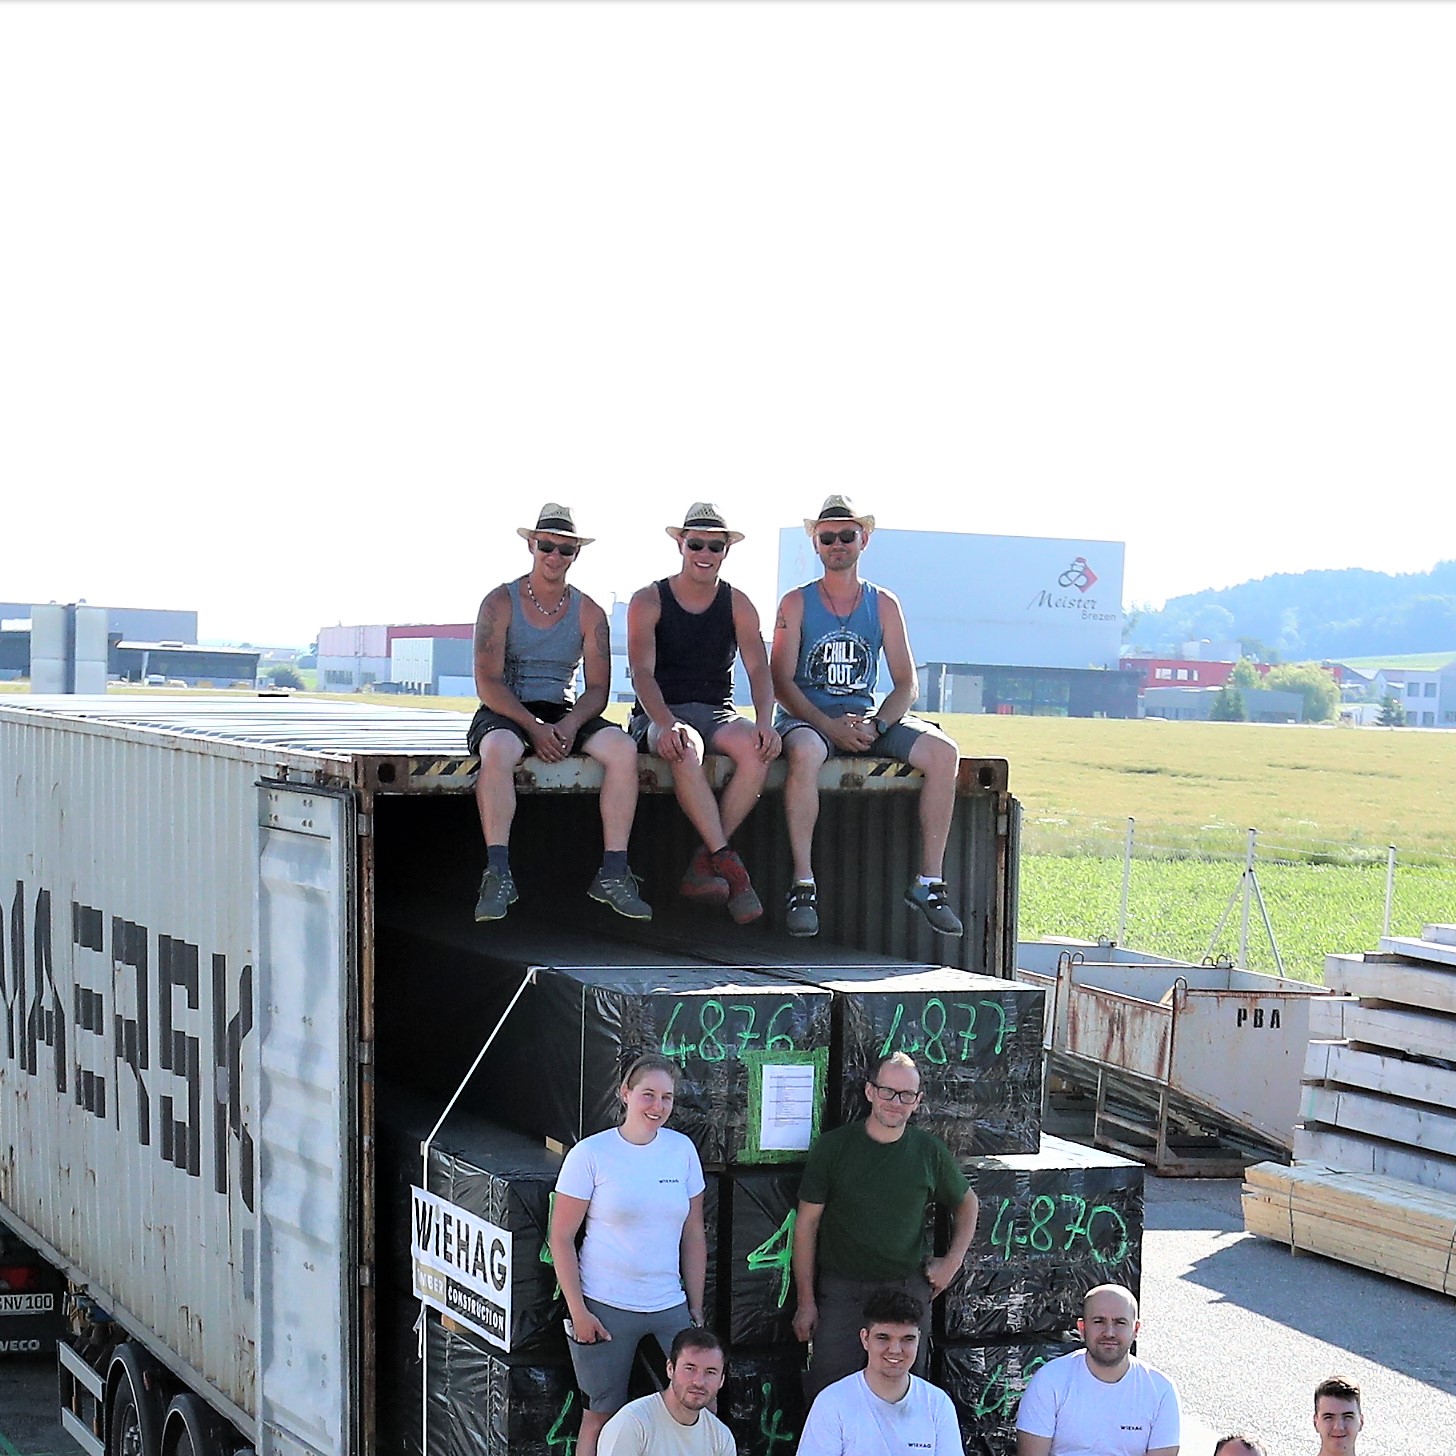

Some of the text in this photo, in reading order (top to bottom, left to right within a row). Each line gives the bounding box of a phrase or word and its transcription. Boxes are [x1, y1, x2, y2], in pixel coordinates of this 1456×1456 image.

[1027, 590, 1097, 609] Meister
[1081, 610, 1116, 621] Brezen
[823, 641, 858, 663] CHILL
[827, 663, 853, 685] OUT
[1237, 1008, 1281, 1029] PBA
[662, 999, 794, 1068] 4876
[879, 997, 1017, 1065] 4877
[990, 1194, 1128, 1266] 4870
[25, 1295, 52, 1310] 100
[447, 1285, 505, 1332] CONSTRUCTION
